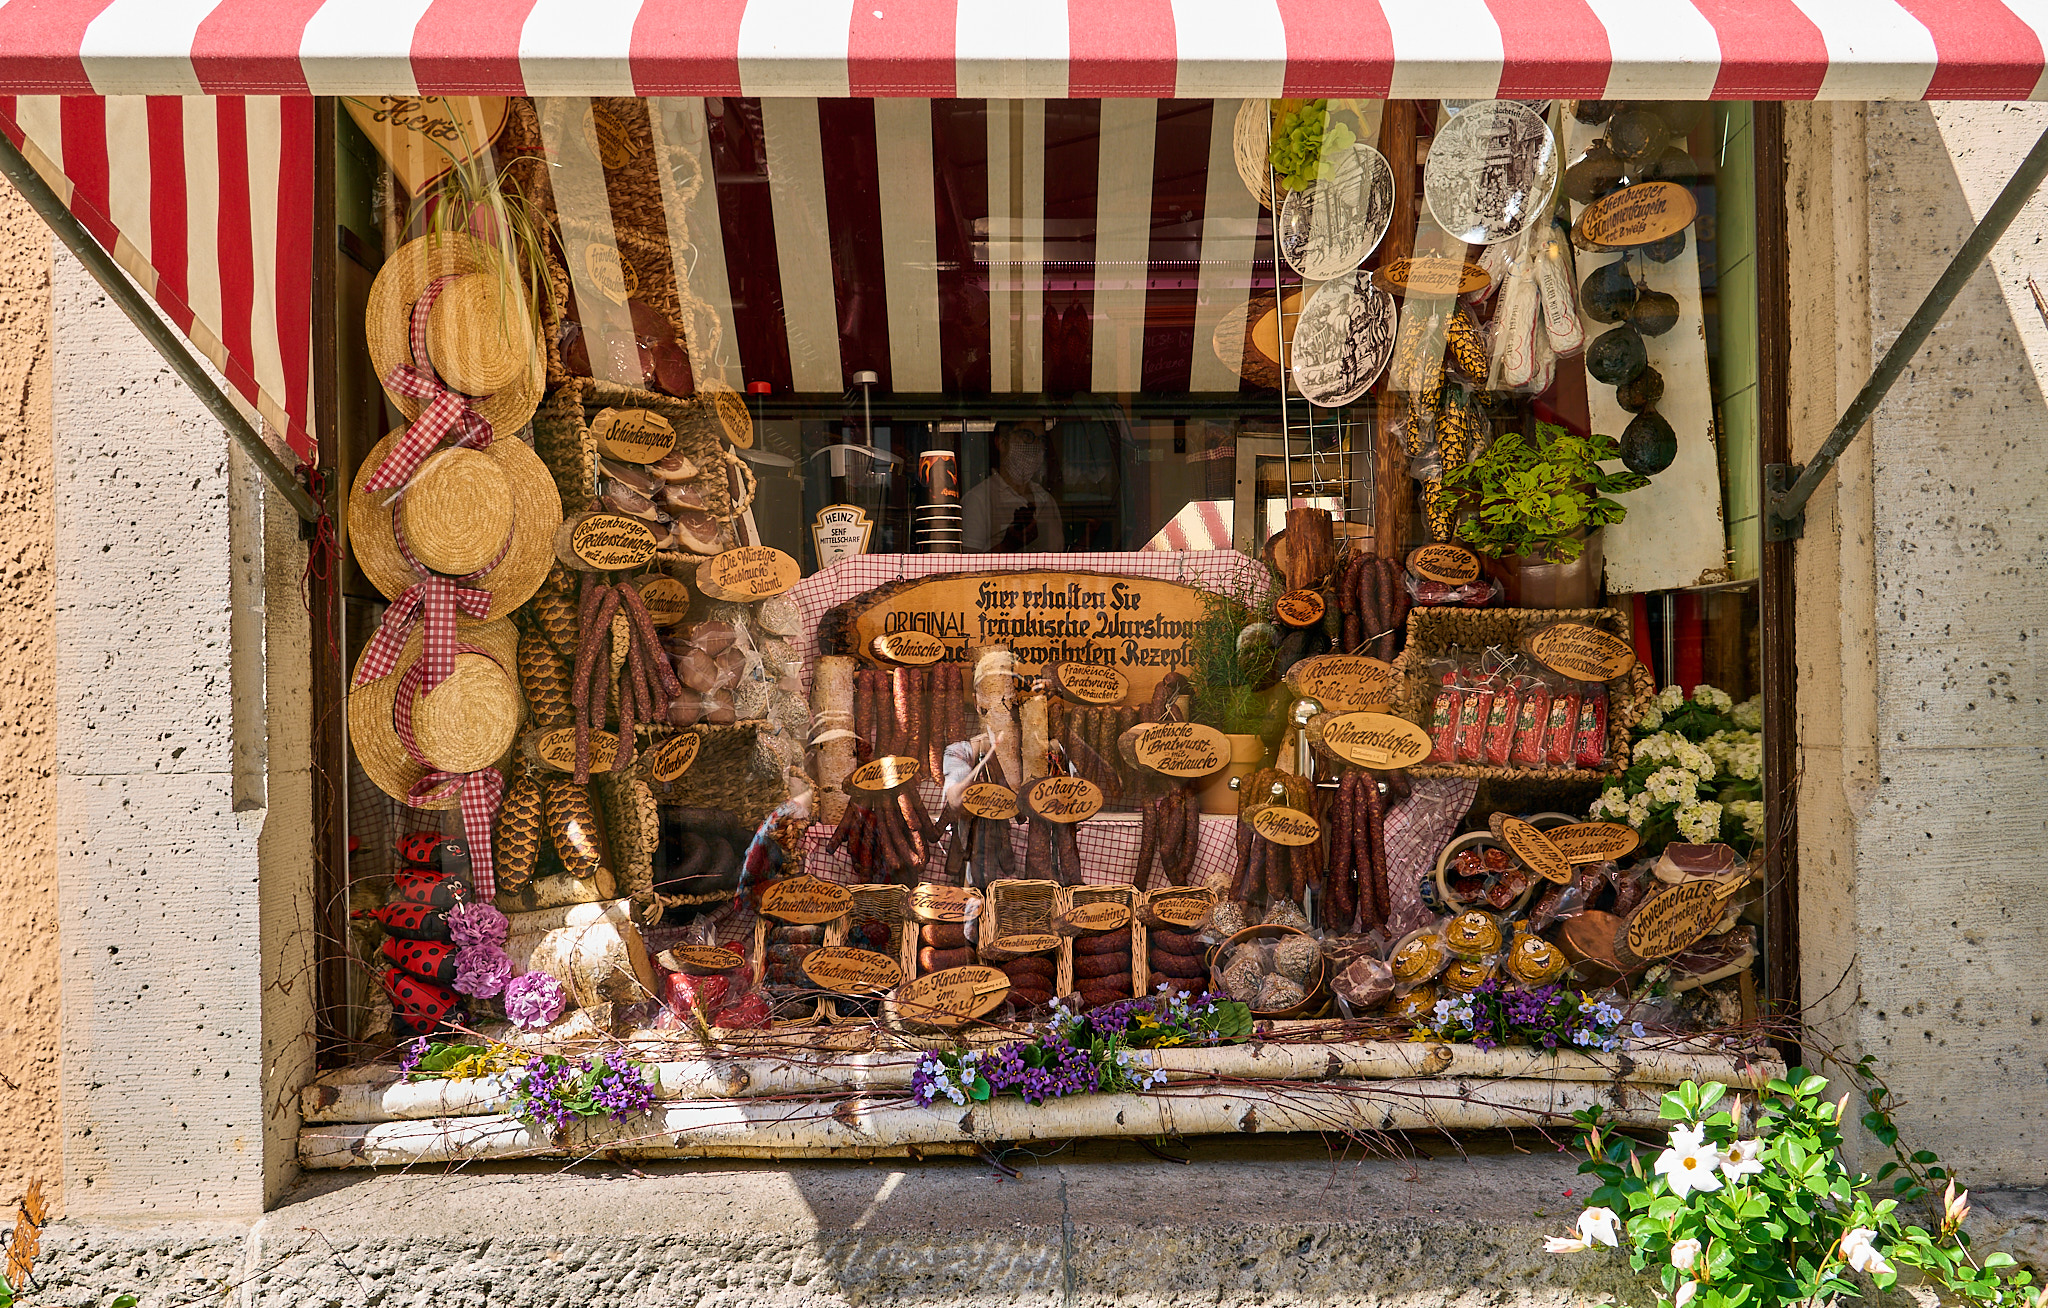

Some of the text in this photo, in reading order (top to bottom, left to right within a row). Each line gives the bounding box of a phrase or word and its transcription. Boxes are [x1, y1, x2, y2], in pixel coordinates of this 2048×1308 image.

[1586, 185, 1667, 230] Rothenburger
[606, 419, 674, 452] Schinkenspeck
[574, 516, 648, 540] Rothenburger
[825, 512, 854, 524] HEINZ
[831, 528, 847, 536] SENF
[720, 553, 738, 572] Die
[1423, 546, 1472, 564] würzige
[750, 571, 782, 594] Salami
[975, 581, 1141, 612] Hier erhalten Sie
[885, 611, 970, 636] ORIGINAL
[978, 611, 1090, 644] fränkische
[886, 637, 942, 658] Polnische
[1064, 664, 1116, 680] fränkische
[1066, 676, 1119, 690] Bratwurst
[1140, 723, 1193, 750] fränkische
[1147, 737, 1210, 755] Bratwurst
[1325, 721, 1421, 758] Winzerstecken
[1157, 752, 1218, 770] Bärlauch
[1034, 779, 1091, 800] Scharfe
[1040, 799, 1093, 815] Berta
[809, 948, 892, 970] fränkisches
